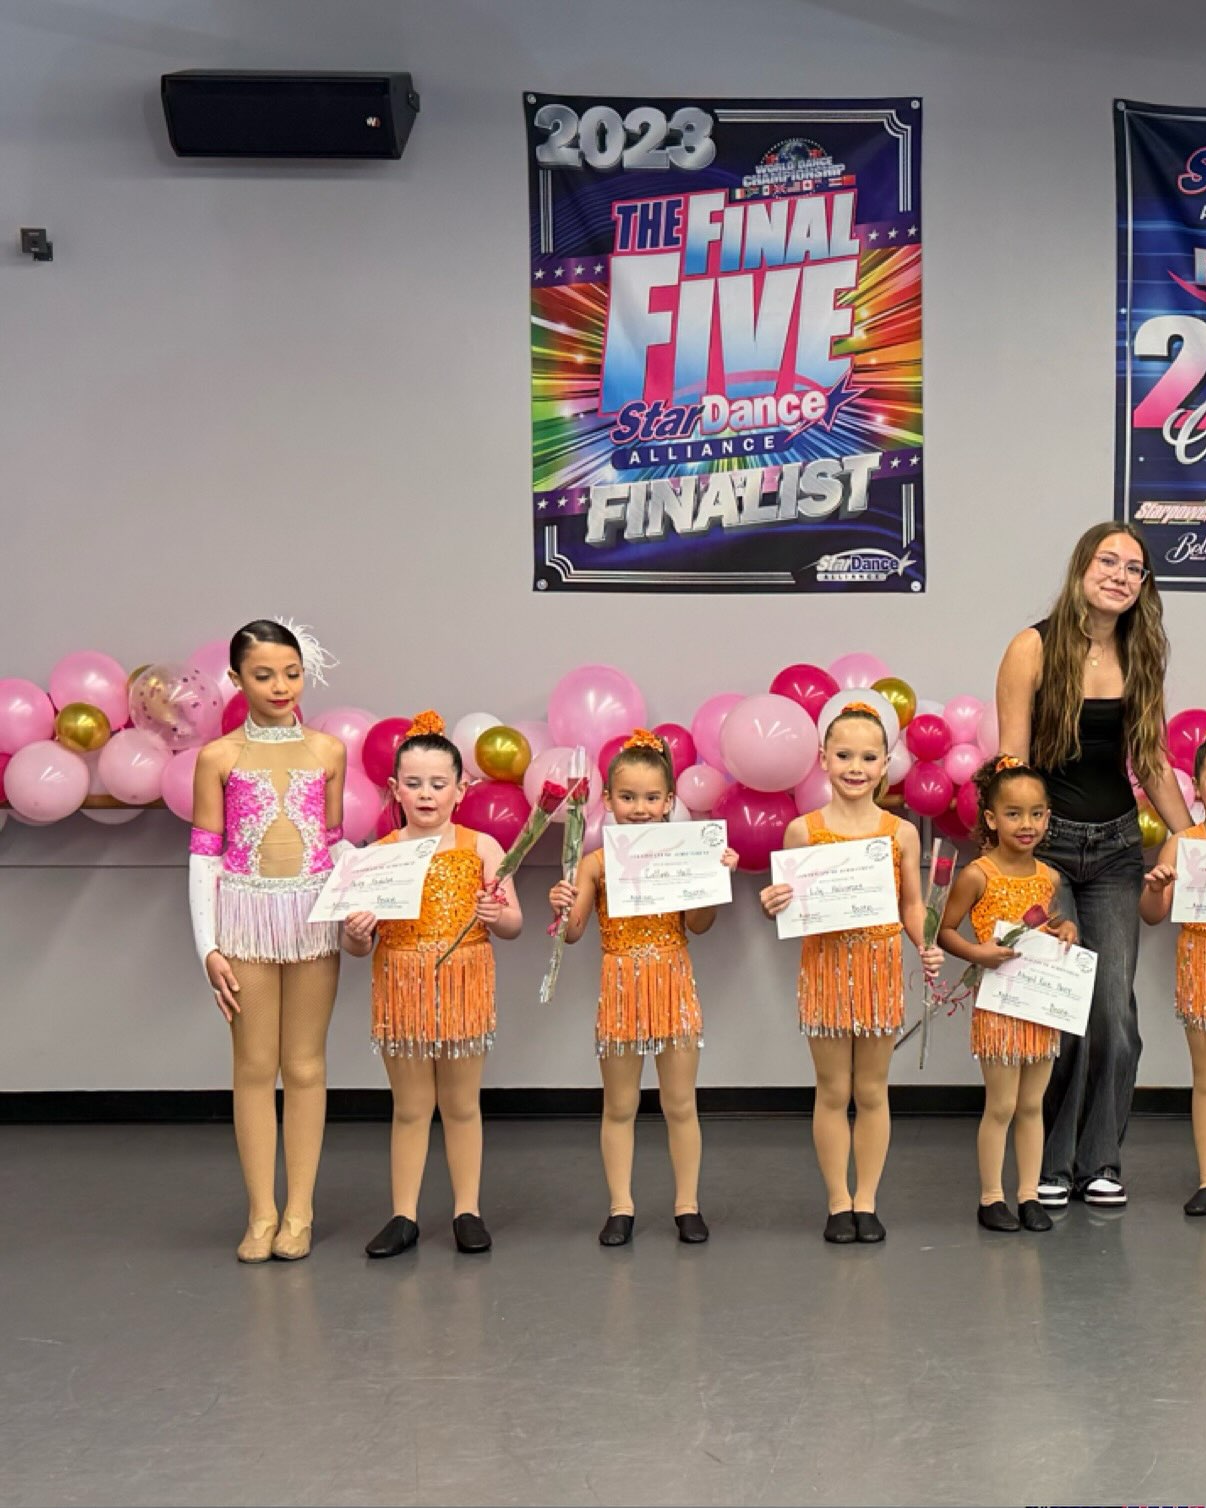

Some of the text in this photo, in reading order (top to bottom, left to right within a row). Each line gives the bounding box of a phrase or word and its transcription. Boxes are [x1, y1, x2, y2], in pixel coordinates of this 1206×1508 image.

[535, 103, 716, 170] 2023
[614, 191, 860, 276] THE FINAL
[598, 252, 860, 415] FIVE
[609, 390, 828, 443] StarDance
[628, 434, 776, 464] ALLIANCE
[585, 451, 883, 544] FINALIST
